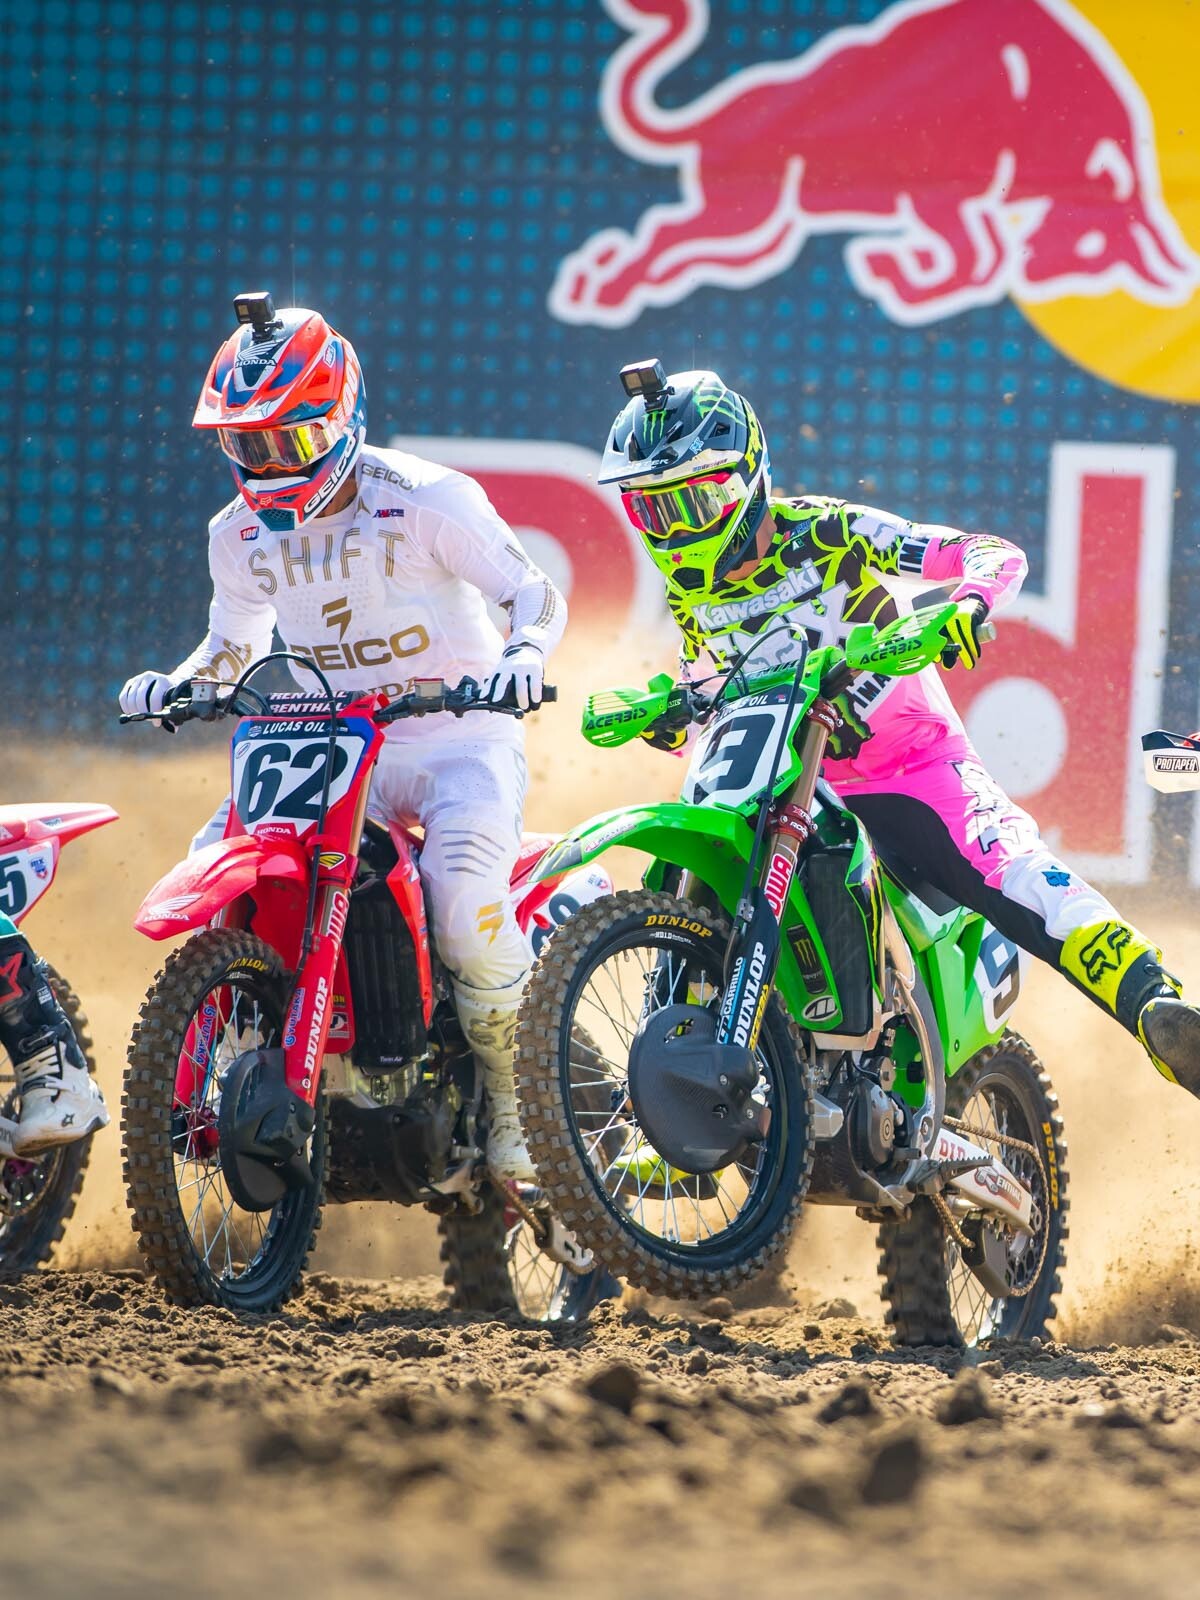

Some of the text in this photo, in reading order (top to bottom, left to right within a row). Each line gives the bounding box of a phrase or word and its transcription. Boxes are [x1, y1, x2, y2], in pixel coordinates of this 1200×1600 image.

[235, 358, 277, 368] HONDA
[248, 527, 406, 596] SHIFT
[691, 559, 823, 632] Kawasaki
[289, 624, 430, 672] GEICO
[859, 636, 922, 665] ACERBIS
[748, 694, 769, 706] OIL
[262, 721, 300, 736] LUCAS
[303, 721, 327, 733] OIL
[585, 708, 648, 732] ACERBIS
[1154, 756, 1199, 773] PROTAPER
[236, 742, 350, 826] 62
[256, 826, 292, 836] HONDA
[143, 910, 191, 924] HONDA
[644, 914, 714, 938] DUNLOP
[226, 957, 269, 972] DUNLOP
[723, 956, 744, 1015] CARRILLO
[733, 941, 771, 1049] DUNLOP
[304, 976, 328, 1078] DUNLOP
